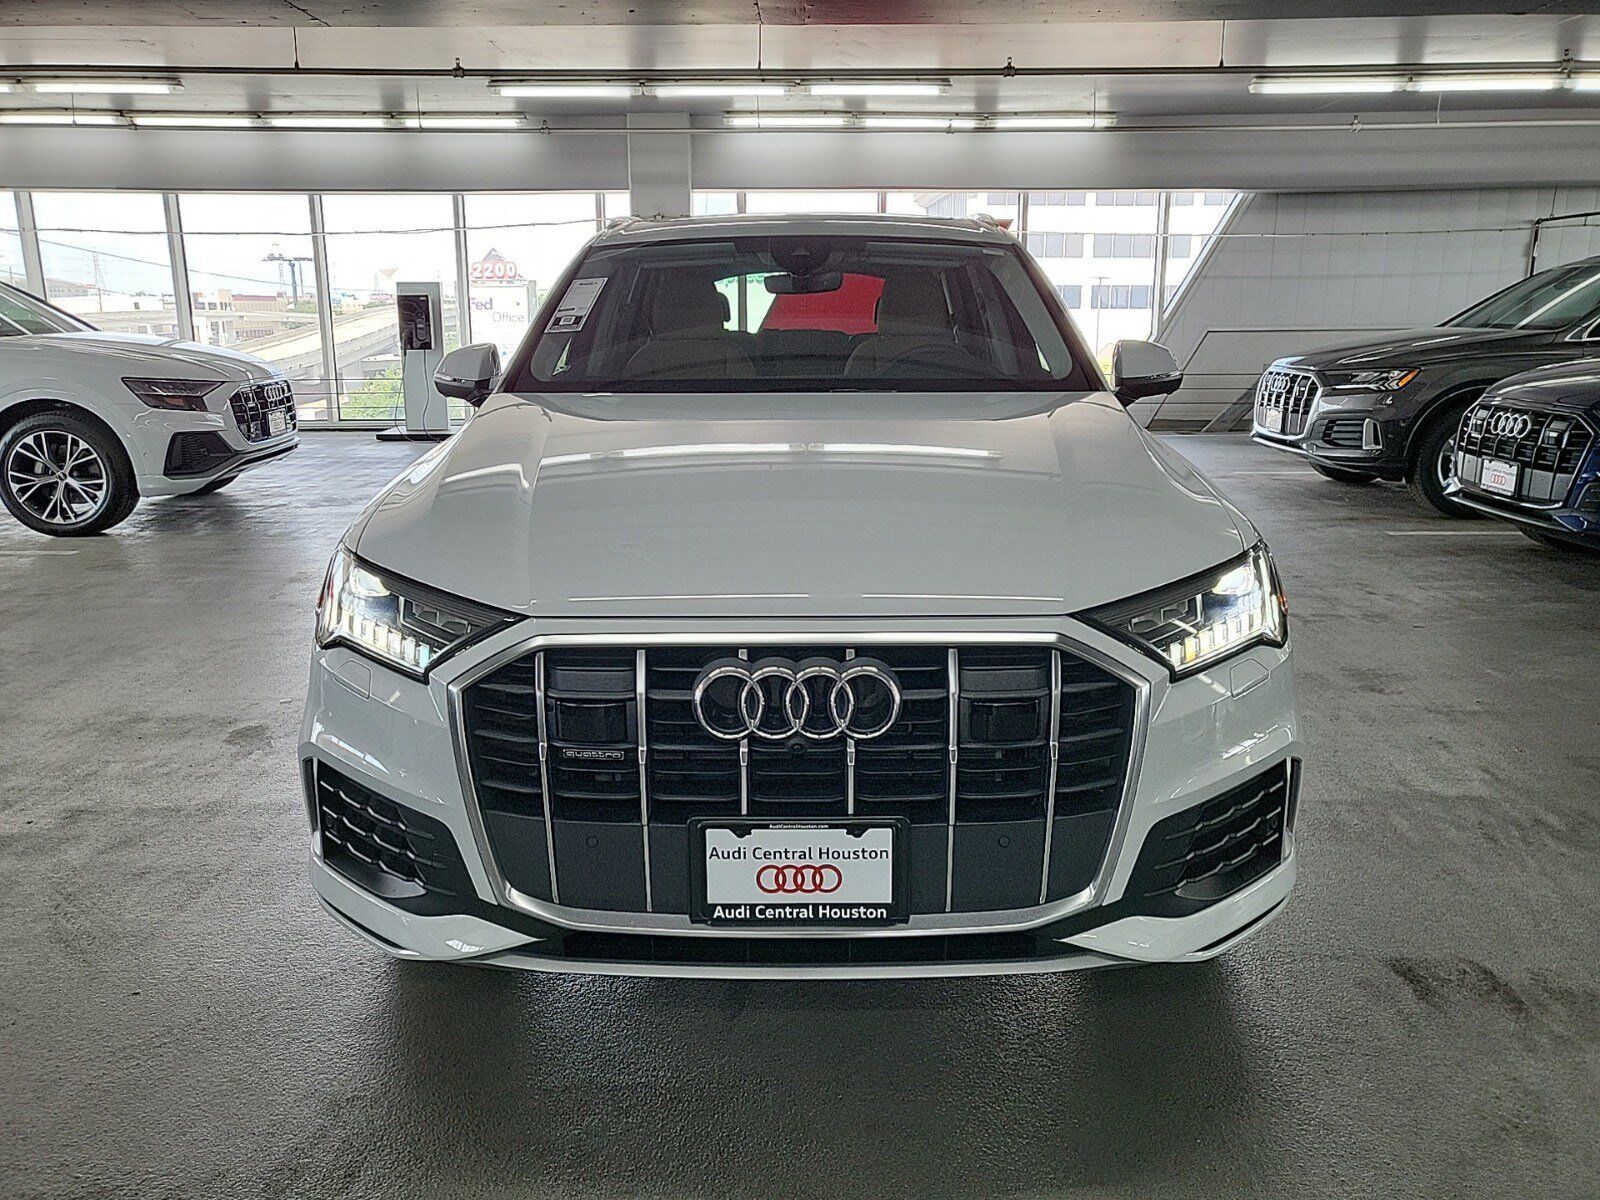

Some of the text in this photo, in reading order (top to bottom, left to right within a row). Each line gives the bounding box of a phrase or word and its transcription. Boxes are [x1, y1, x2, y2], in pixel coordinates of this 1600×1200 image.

[471, 261, 517, 279] 2200
[492, 311, 525, 322] Office
[565, 750, 621, 759] quattro
[708, 846, 889, 860] Audi Central Houston
[713, 905, 887, 919] Audi Central Houston
